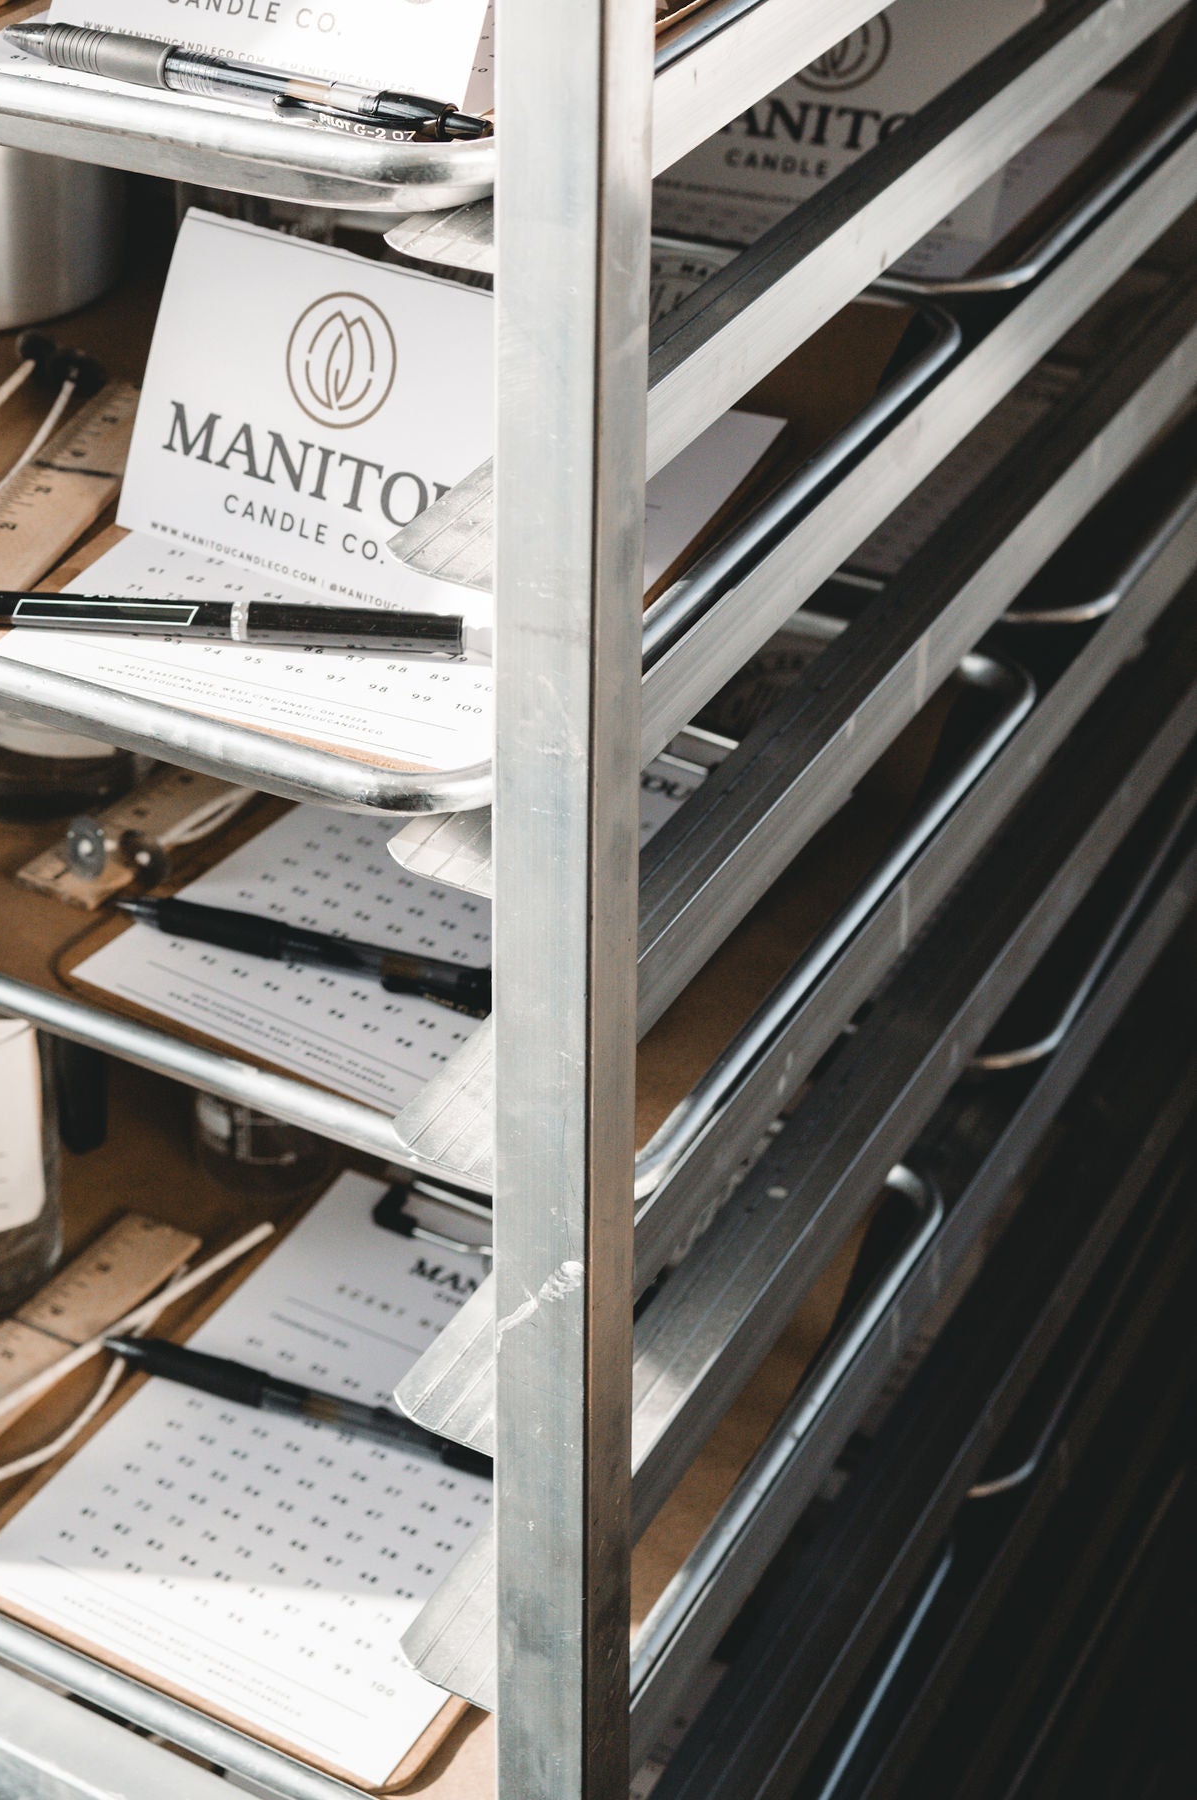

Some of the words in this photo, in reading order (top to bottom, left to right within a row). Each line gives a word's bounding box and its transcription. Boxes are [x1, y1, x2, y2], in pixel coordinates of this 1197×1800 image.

[295, 7, 343, 36] CO.
[319, 113, 351, 130] PILOT
[353, 123, 387, 140] G-2
[725, 147, 828, 178] CANDLE
[162, 400, 454, 528] MANITO
[223, 494, 329, 545] CANDLE
[342, 533, 384, 564] CO.
[455, 703, 483, 714] 100
[371, 1681, 395, 1696] 100
